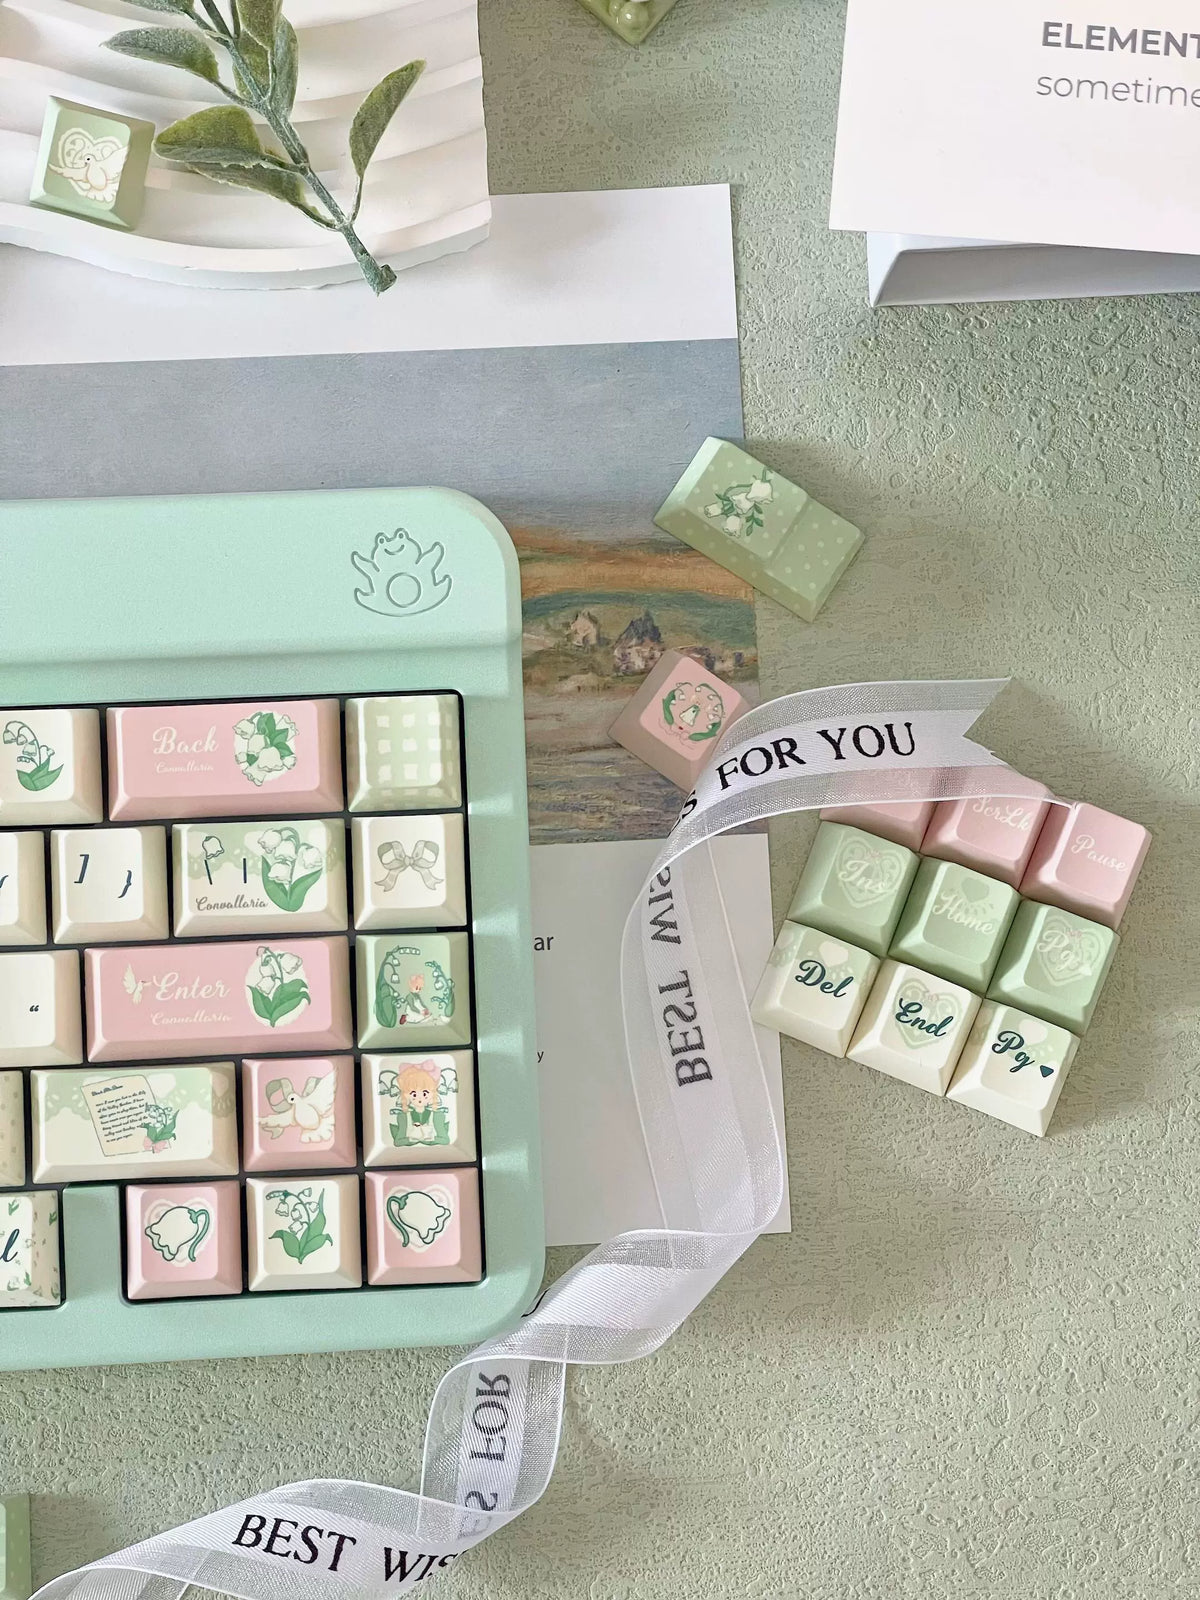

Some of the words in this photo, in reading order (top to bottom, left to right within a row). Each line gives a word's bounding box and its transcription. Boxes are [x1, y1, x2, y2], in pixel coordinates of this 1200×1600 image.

[152, 725, 219, 755] Back
[715, 737, 806, 790] FOR
[816, 721, 915, 761] YOU
[1071, 834, 1128, 872] Pause
[838, 860, 888, 892] Ins
[195, 895, 269, 912] Convallaria
[933, 889, 996, 935] Home
[150, 971, 231, 1001] Enter
[795, 959, 854, 998] Del
[895, 998, 954, 1037] End
[991, 1030, 1036, 1073] Pg
[232, 1514, 357, 1572] BEST
